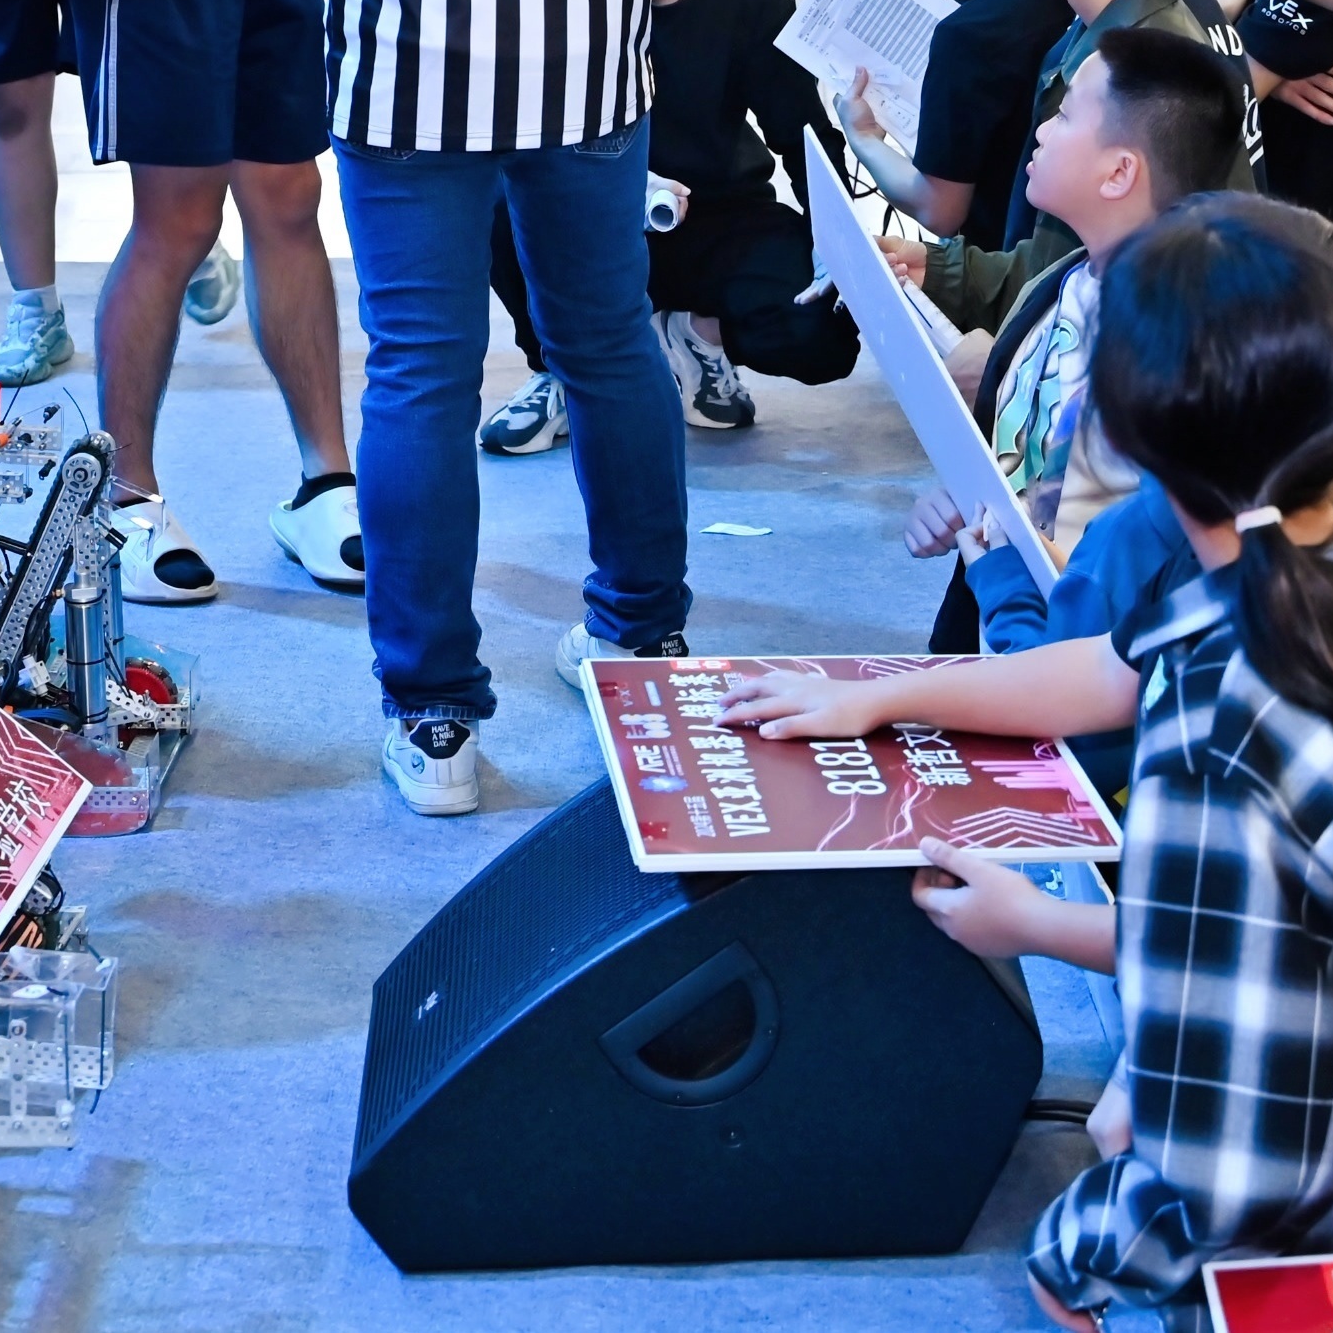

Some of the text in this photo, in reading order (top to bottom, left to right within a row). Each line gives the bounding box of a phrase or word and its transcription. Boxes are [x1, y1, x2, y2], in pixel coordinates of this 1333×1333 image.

[1261, 7, 1307, 36] ROBOTICS
[661, 639, 679, 649] HAVE
[431, 723, 450, 734] HAVE
[432, 733, 438, 741] A
[892, 723, 972, 786] 新哲文
[809, 739, 887, 795] 8181
